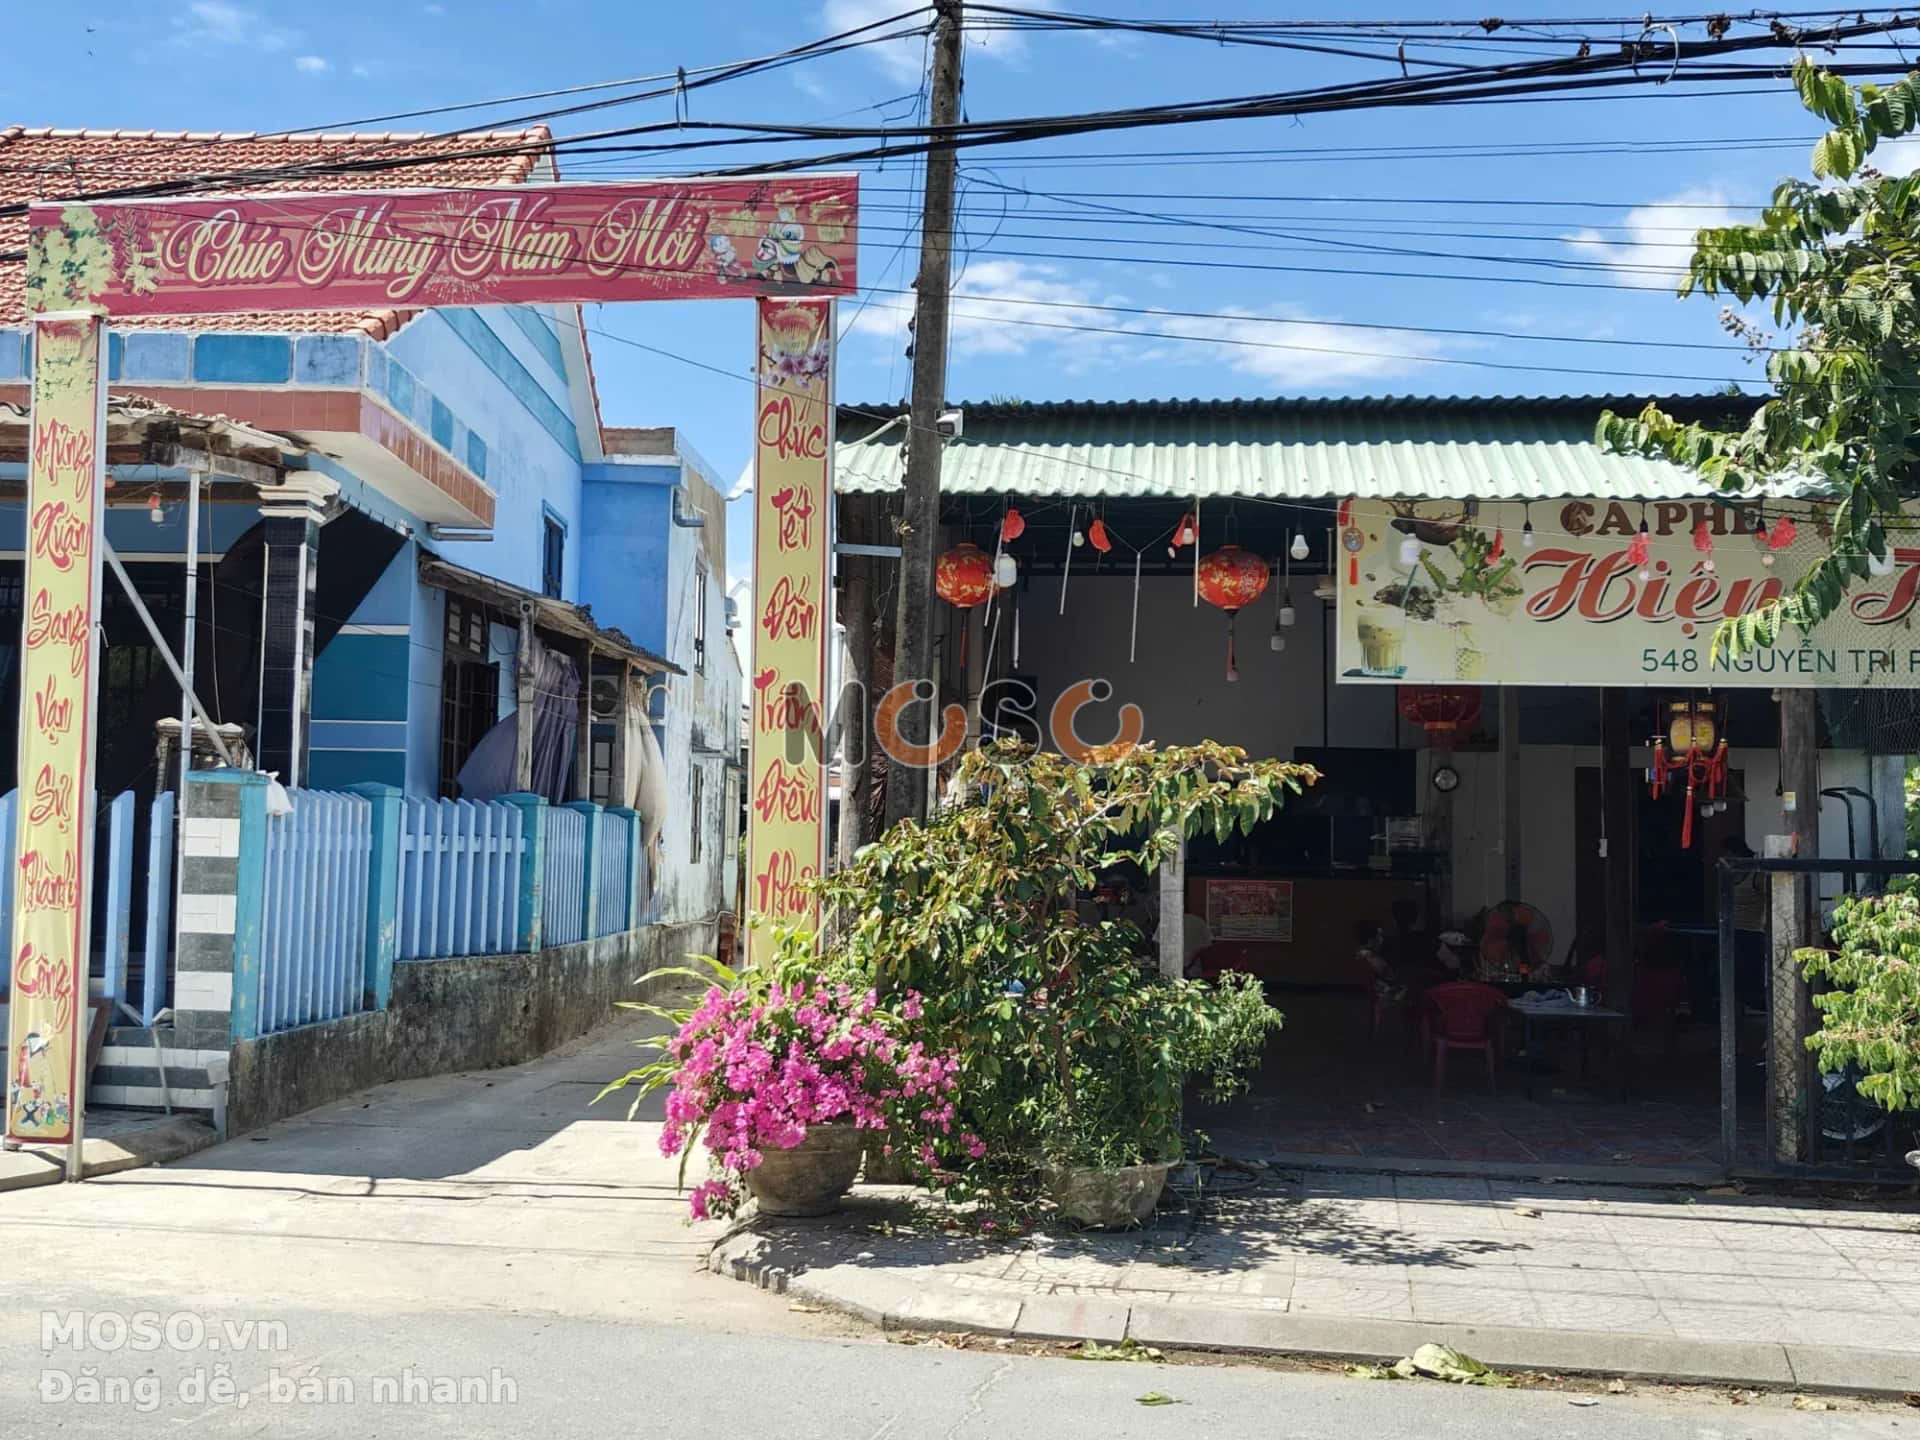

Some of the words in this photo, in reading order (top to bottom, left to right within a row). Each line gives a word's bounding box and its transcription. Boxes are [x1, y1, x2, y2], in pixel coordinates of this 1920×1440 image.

[166, 207, 285, 284] Chúc
[298, 199, 438, 299] Mừng
[451, 196, 574, 276] Năm
[587, 193, 700, 277] Mới
[758, 394, 827, 460] Chúc
[32, 501, 87, 568] Xuân
[770, 486, 813, 551] Tết
[26, 587, 89, 675] Sang
[762, 575, 816, 641] Đến
[1641, 648, 1699, 673] 548
[36, 674, 70, 741] Vạn
[29, 763, 70, 830] Sự
[755, 758, 818, 823] Điều
[19, 850, 78, 908] Thành
[17, 942, 71, 1031] Công
